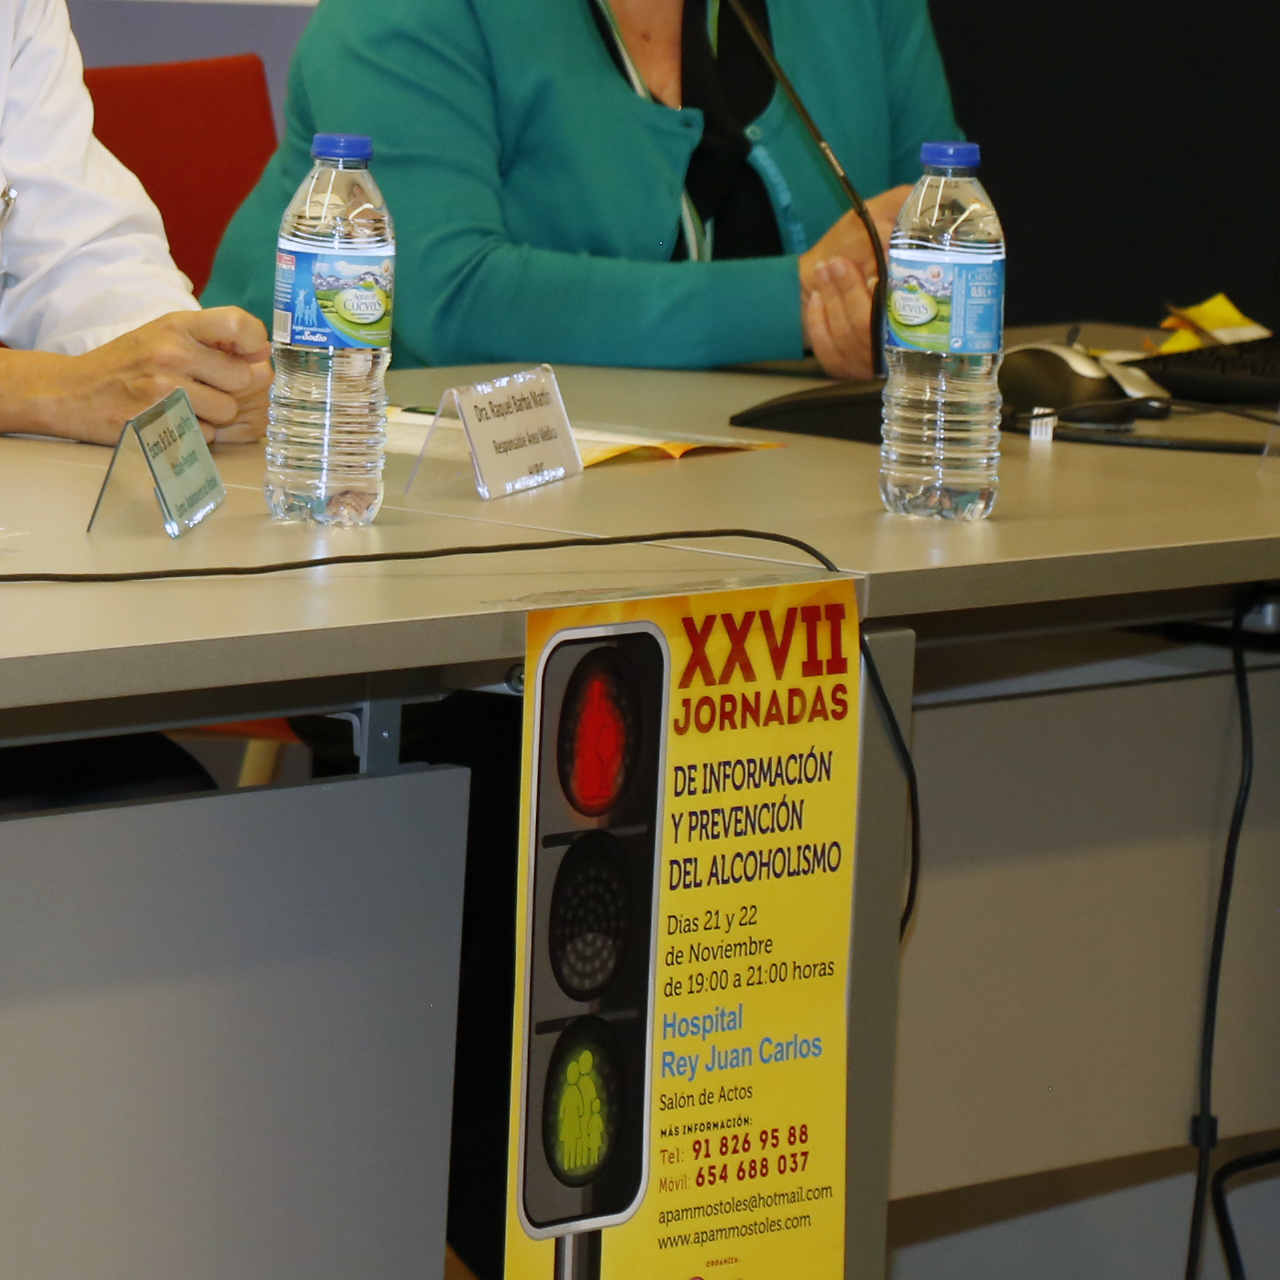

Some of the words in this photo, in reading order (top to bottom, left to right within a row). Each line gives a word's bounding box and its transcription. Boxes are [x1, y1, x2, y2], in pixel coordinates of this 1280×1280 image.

[678, 602, 848, 689] XXVII
[673, 683, 848, 736] JORNADAS
[674, 765, 697, 797] DE
[702, 745, 832, 795] INFORMACIÓN
[671, 812, 684, 844] Y
[688, 794, 804, 842] PREVENCIÓN
[669, 858, 702, 891] DEL
[707, 840, 841, 886] ALCOHOLISMO
[667, 913, 699, 936] Días
[703, 910, 721, 931] 21
[725, 914, 735, 934] y
[739, 905, 758, 926] 22
[665, 946, 684, 967] de
[689, 936, 773, 965] Noviembre
[663, 976, 683, 998] de
[687, 969, 729, 995] 19:00
[733, 973, 742, 988] a
[746, 961, 788, 986] 21:00
[792, 958, 835, 980] horas
[662, 1003, 743, 1042] Hospital
[661, 1050, 699, 1082] Rey
[705, 1044, 753, 1072] Juan
[759, 1033, 822, 1064] Carlos
[659, 1090, 695, 1112] Salón
[699, 1088, 714, 1106] de
[718, 1084, 753, 1102] Actos
[660, 1124, 680, 1138] MÁS
[683, 1115, 752, 1135] INFORMACIÓN:
[660, 1148, 684, 1165] Tel:
[692, 1138, 711, 1160] 91
[719, 1132, 751, 1156] 826
[759, 1128, 780, 1150] 95
[787, 1124, 809, 1146] 88
[659, 1174, 690, 1194] Móvil:
[695, 1164, 728, 1187] 654
[737, 1157, 769, 1181] 688
[778, 1151, 809, 1174] 037
[659, 1185, 833, 1227] apammostoles@hotmail.com
[658, 1213, 812, 1250] www.apammostoles.com
